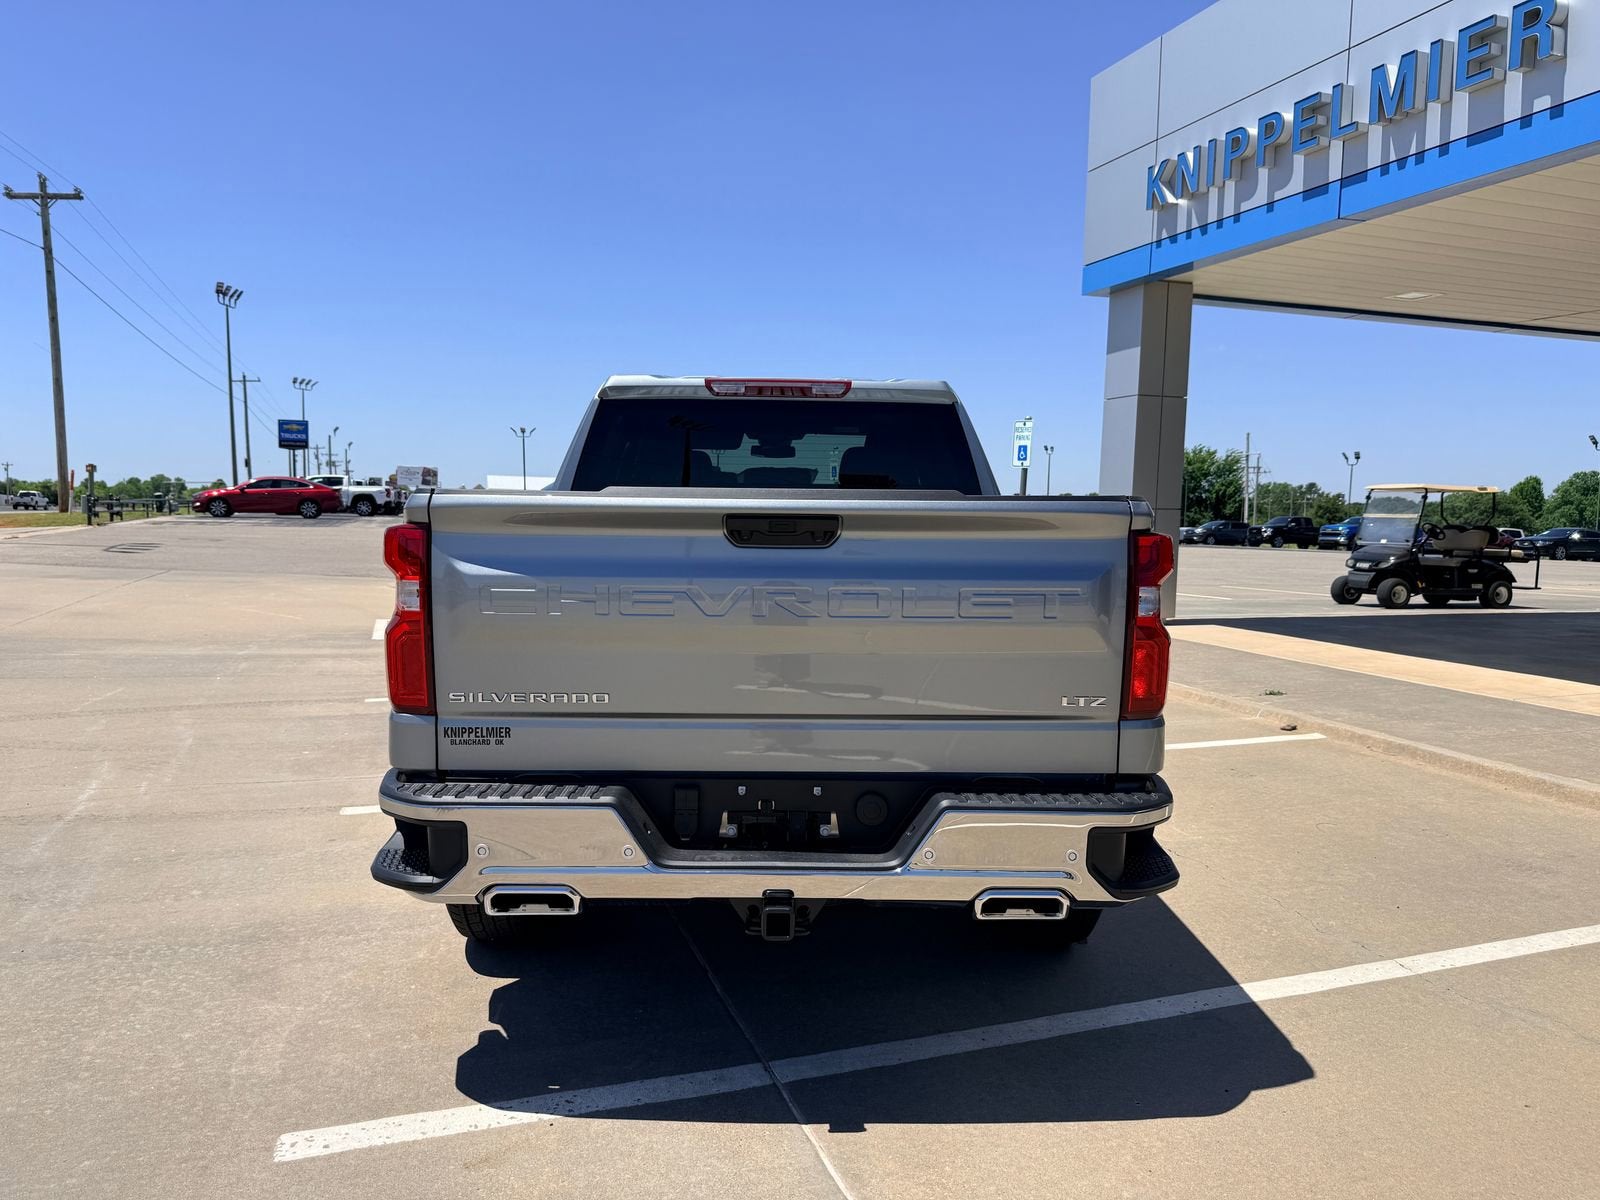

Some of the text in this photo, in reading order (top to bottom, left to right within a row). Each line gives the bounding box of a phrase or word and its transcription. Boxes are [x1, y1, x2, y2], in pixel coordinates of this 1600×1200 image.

[1146, 0, 1560, 210] KNIPPELMIER
[479, 584, 1088, 619] CHEVROLET
[449, 692, 610, 704] SILVERADO
[1061, 696, 1107, 707] LTZ
[443, 726, 511, 738] KNIPPELMIER
